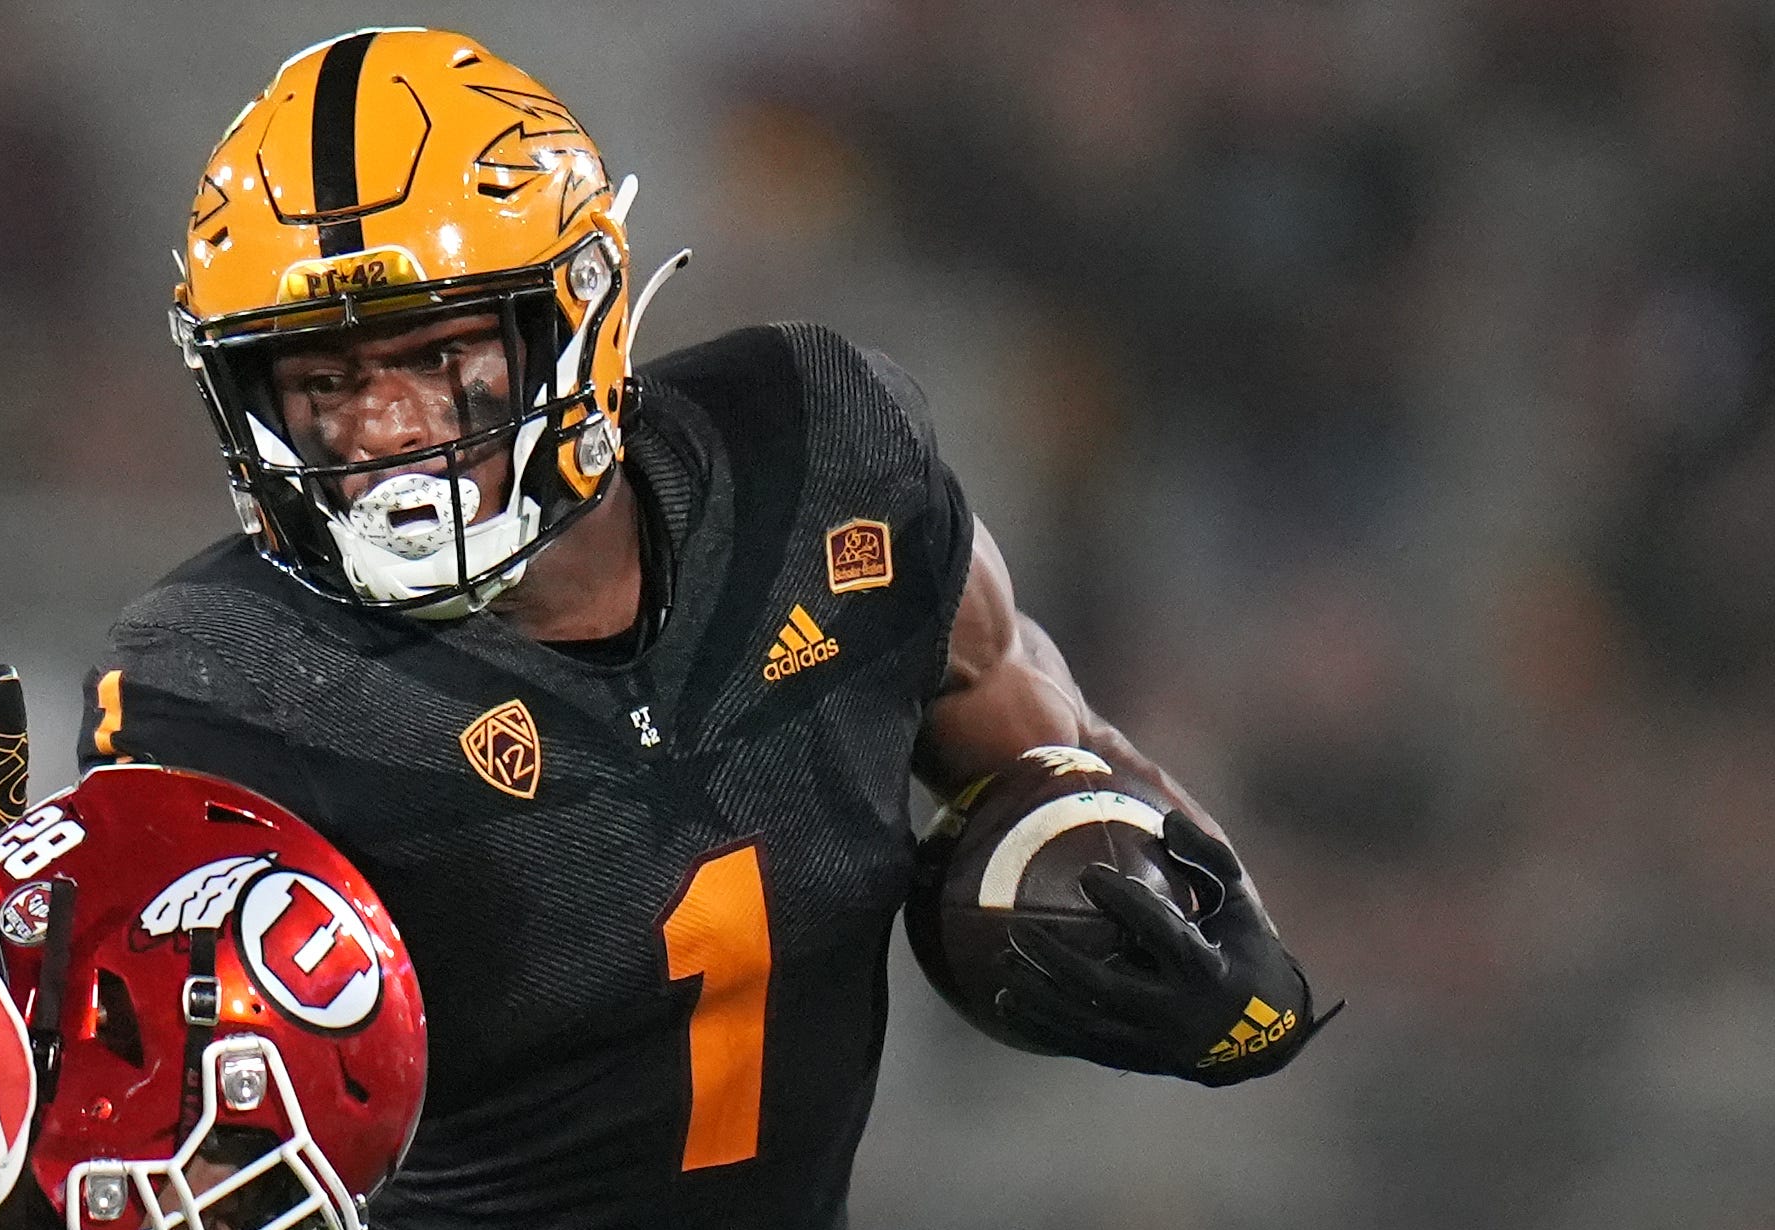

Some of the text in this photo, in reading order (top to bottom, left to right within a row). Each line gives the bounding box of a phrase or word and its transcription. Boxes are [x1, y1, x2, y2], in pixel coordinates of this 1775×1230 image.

[763, 637, 840, 681] adidas
[466, 706, 535, 776] PAC
[495, 744, 535, 786] 12
[260, 879, 373, 1009] U
[662, 845, 772, 1173] 1
[1196, 1008, 1297, 1069] adidas
